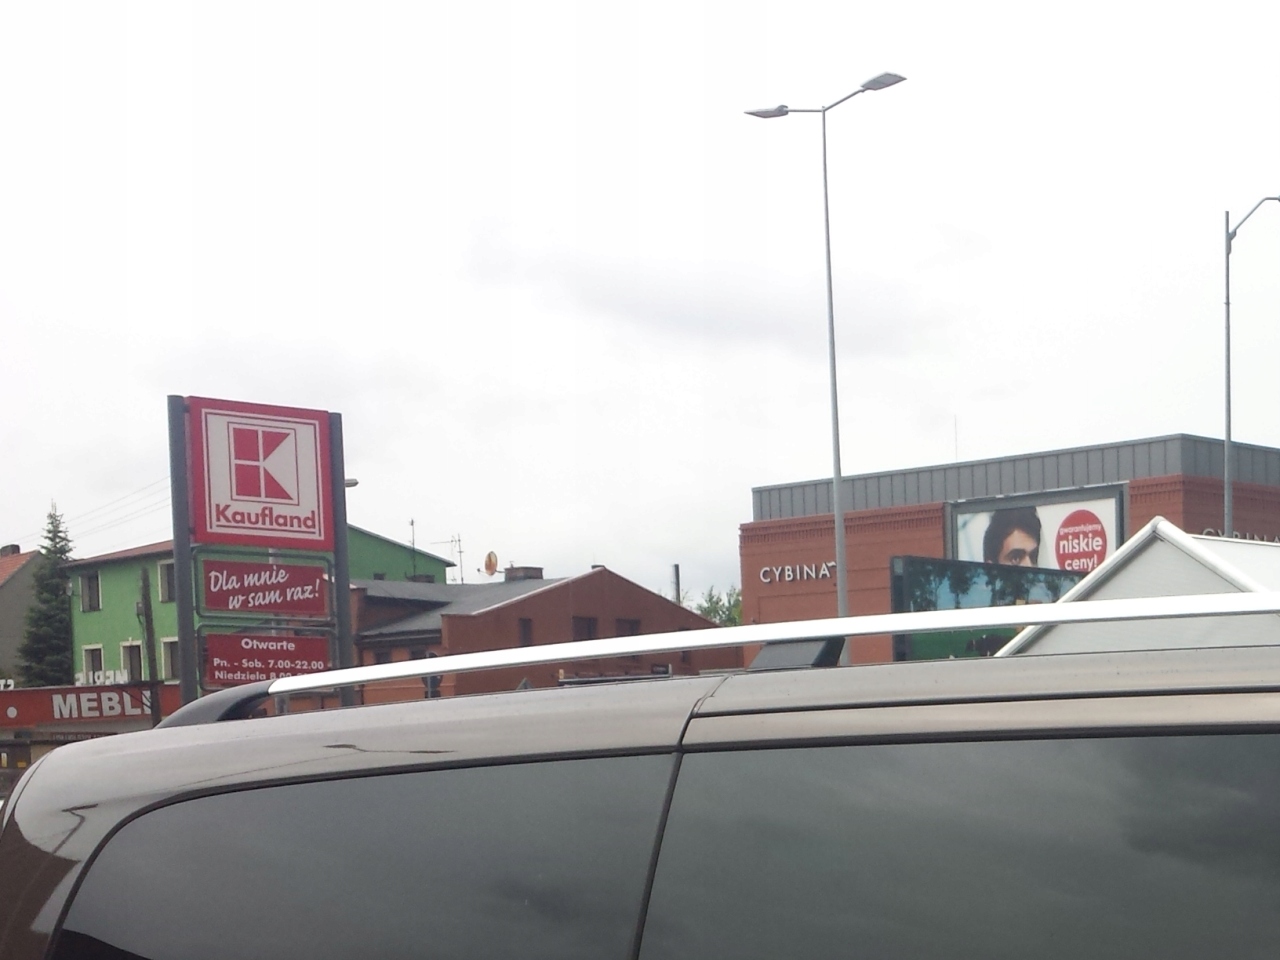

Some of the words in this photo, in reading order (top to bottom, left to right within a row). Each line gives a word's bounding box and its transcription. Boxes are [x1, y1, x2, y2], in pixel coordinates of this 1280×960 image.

[215, 503, 317, 530] Kaufland
[1060, 533, 1102, 554] niskie
[760, 562, 832, 583] CYBINA
[1065, 554, 1098, 572] ceny!
[209, 570, 240, 592] Dla
[244, 565, 290, 588] mnie
[228, 594, 246, 609] w
[248, 589, 283, 607] sam
[286, 579, 320, 602] raz!
[241, 638, 295, 651] Otwarte
[213, 657, 230, 667] Pn.
[241, 658, 265, 669] Sob.
[268, 659, 325, 670] 7.00-22.00
[214, 670, 267, 681] Niedziela
